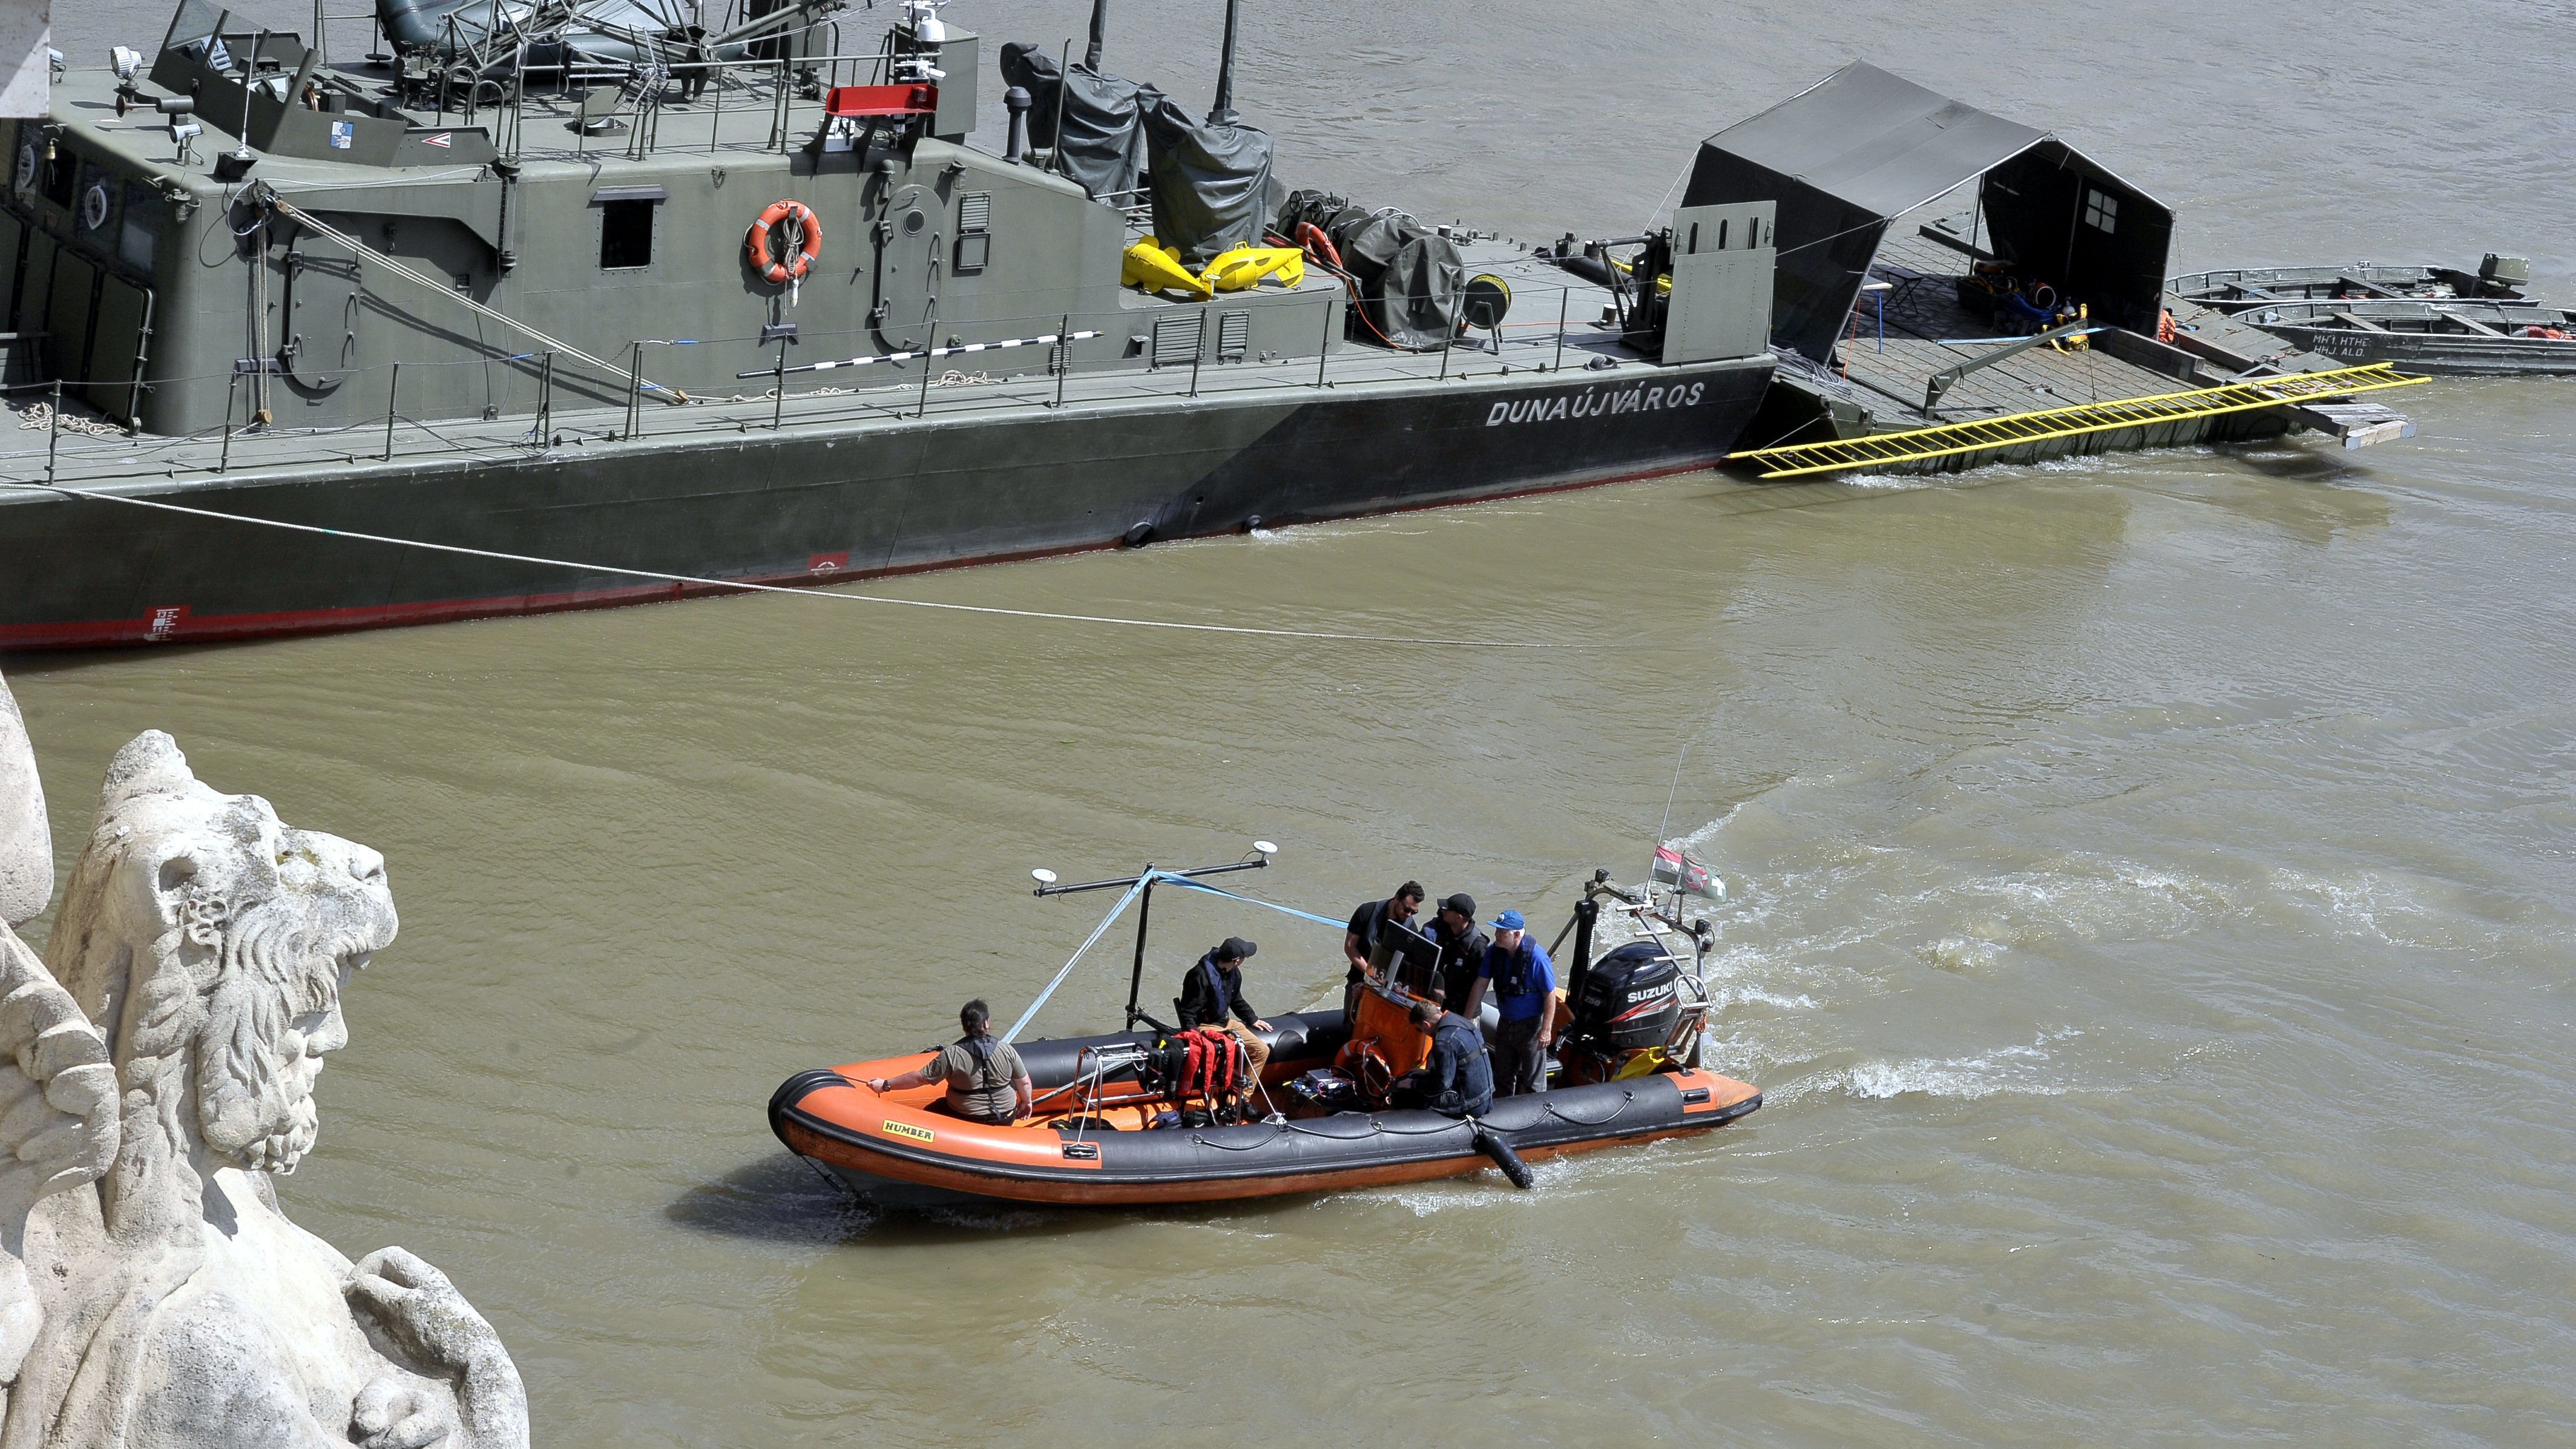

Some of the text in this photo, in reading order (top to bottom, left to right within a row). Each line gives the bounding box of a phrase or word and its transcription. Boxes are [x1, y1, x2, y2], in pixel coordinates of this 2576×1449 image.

[1486, 381, 1704, 427] DUNAÚJVÁROS
[1627, 981, 1673, 1003] SUZUKI
[885, 1122, 932, 1140] HUMBER
